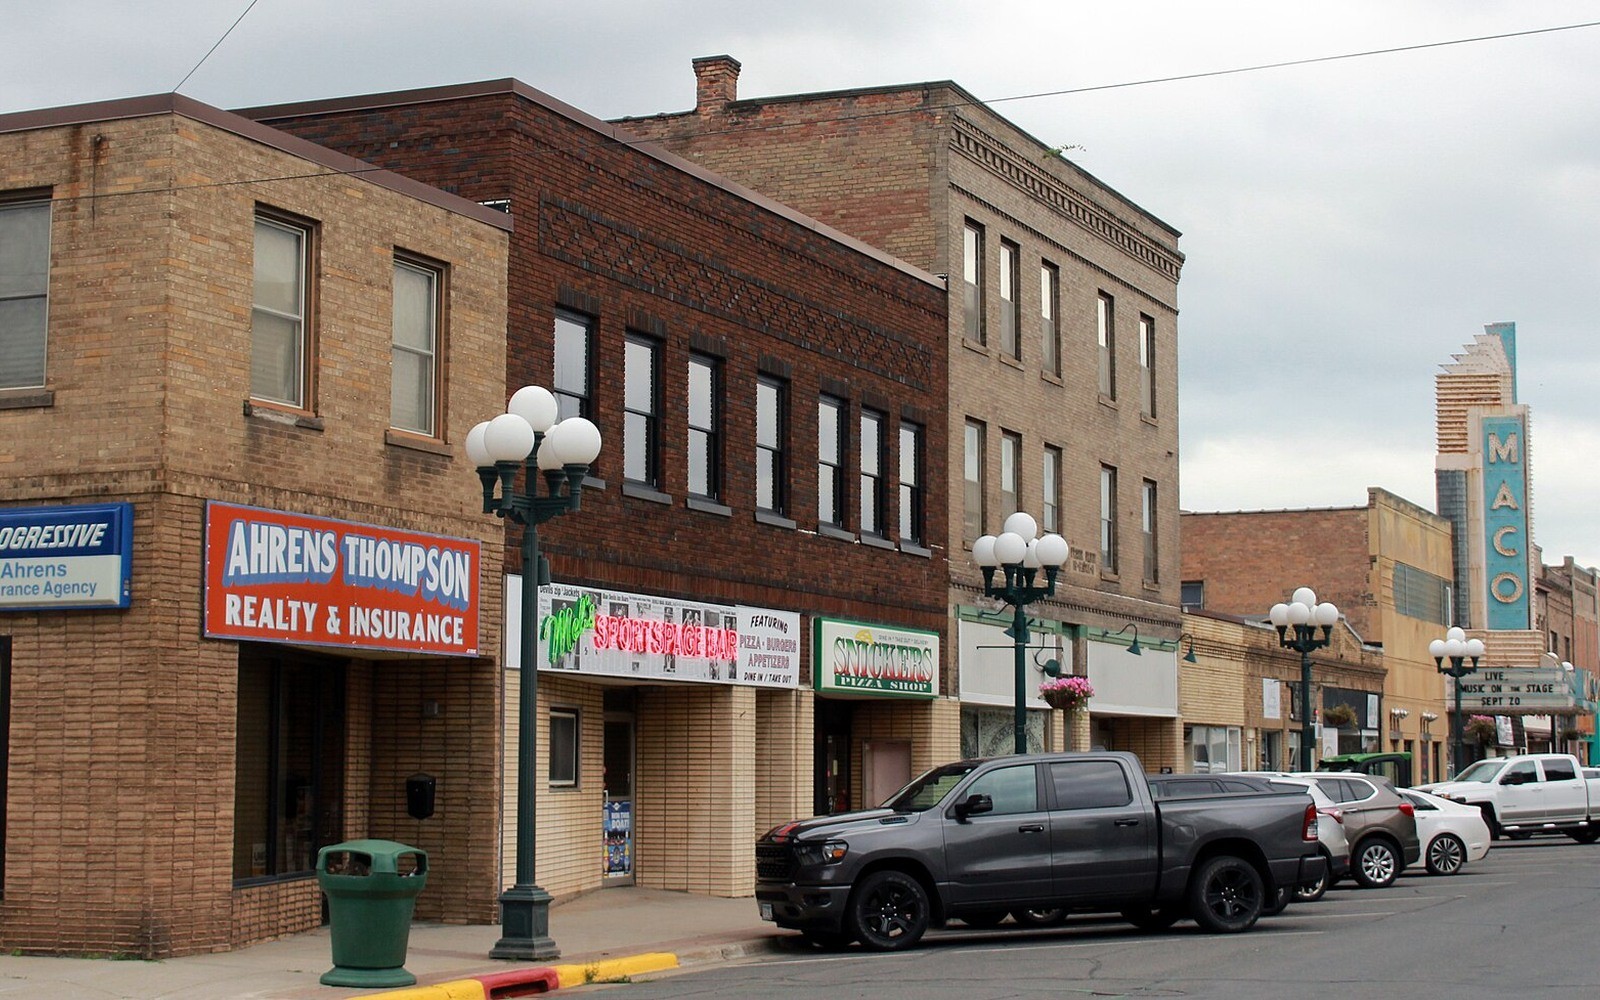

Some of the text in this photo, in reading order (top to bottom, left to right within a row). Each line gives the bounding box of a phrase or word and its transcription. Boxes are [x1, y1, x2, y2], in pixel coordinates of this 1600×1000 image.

[1488, 431, 1524, 604] MACO
[0, 523, 108, 550] OGRESSIVE
[1, 562, 67, 578] Ahrens
[225, 520, 470, 607] AHRENS THOMPSON
[1, 581, 97, 598] rance Agency
[226, 594, 464, 645] REALTY & INSURANCE
[750, 615, 788, 634] FEATURING
[704, 628, 738, 661] BAR
[740, 635, 797, 653] PIZZA BURGERS
[748, 653, 790, 669] APPETIZERS
[834, 637, 933, 682] SNICKERS
[744, 672, 757, 681] DINE
[757, 673, 763, 681] IN
[769, 674, 781, 683] TAKE
[782, 675, 792, 683] OUT
[840, 676, 927, 692] PIZZA SHOP
[1461, 684, 1485, 693] MUSIC
[1491, 684, 1502, 693] ON
[1526, 684, 1554, 693] STAGE
[1481, 697, 1520, 706] SEPT 20
